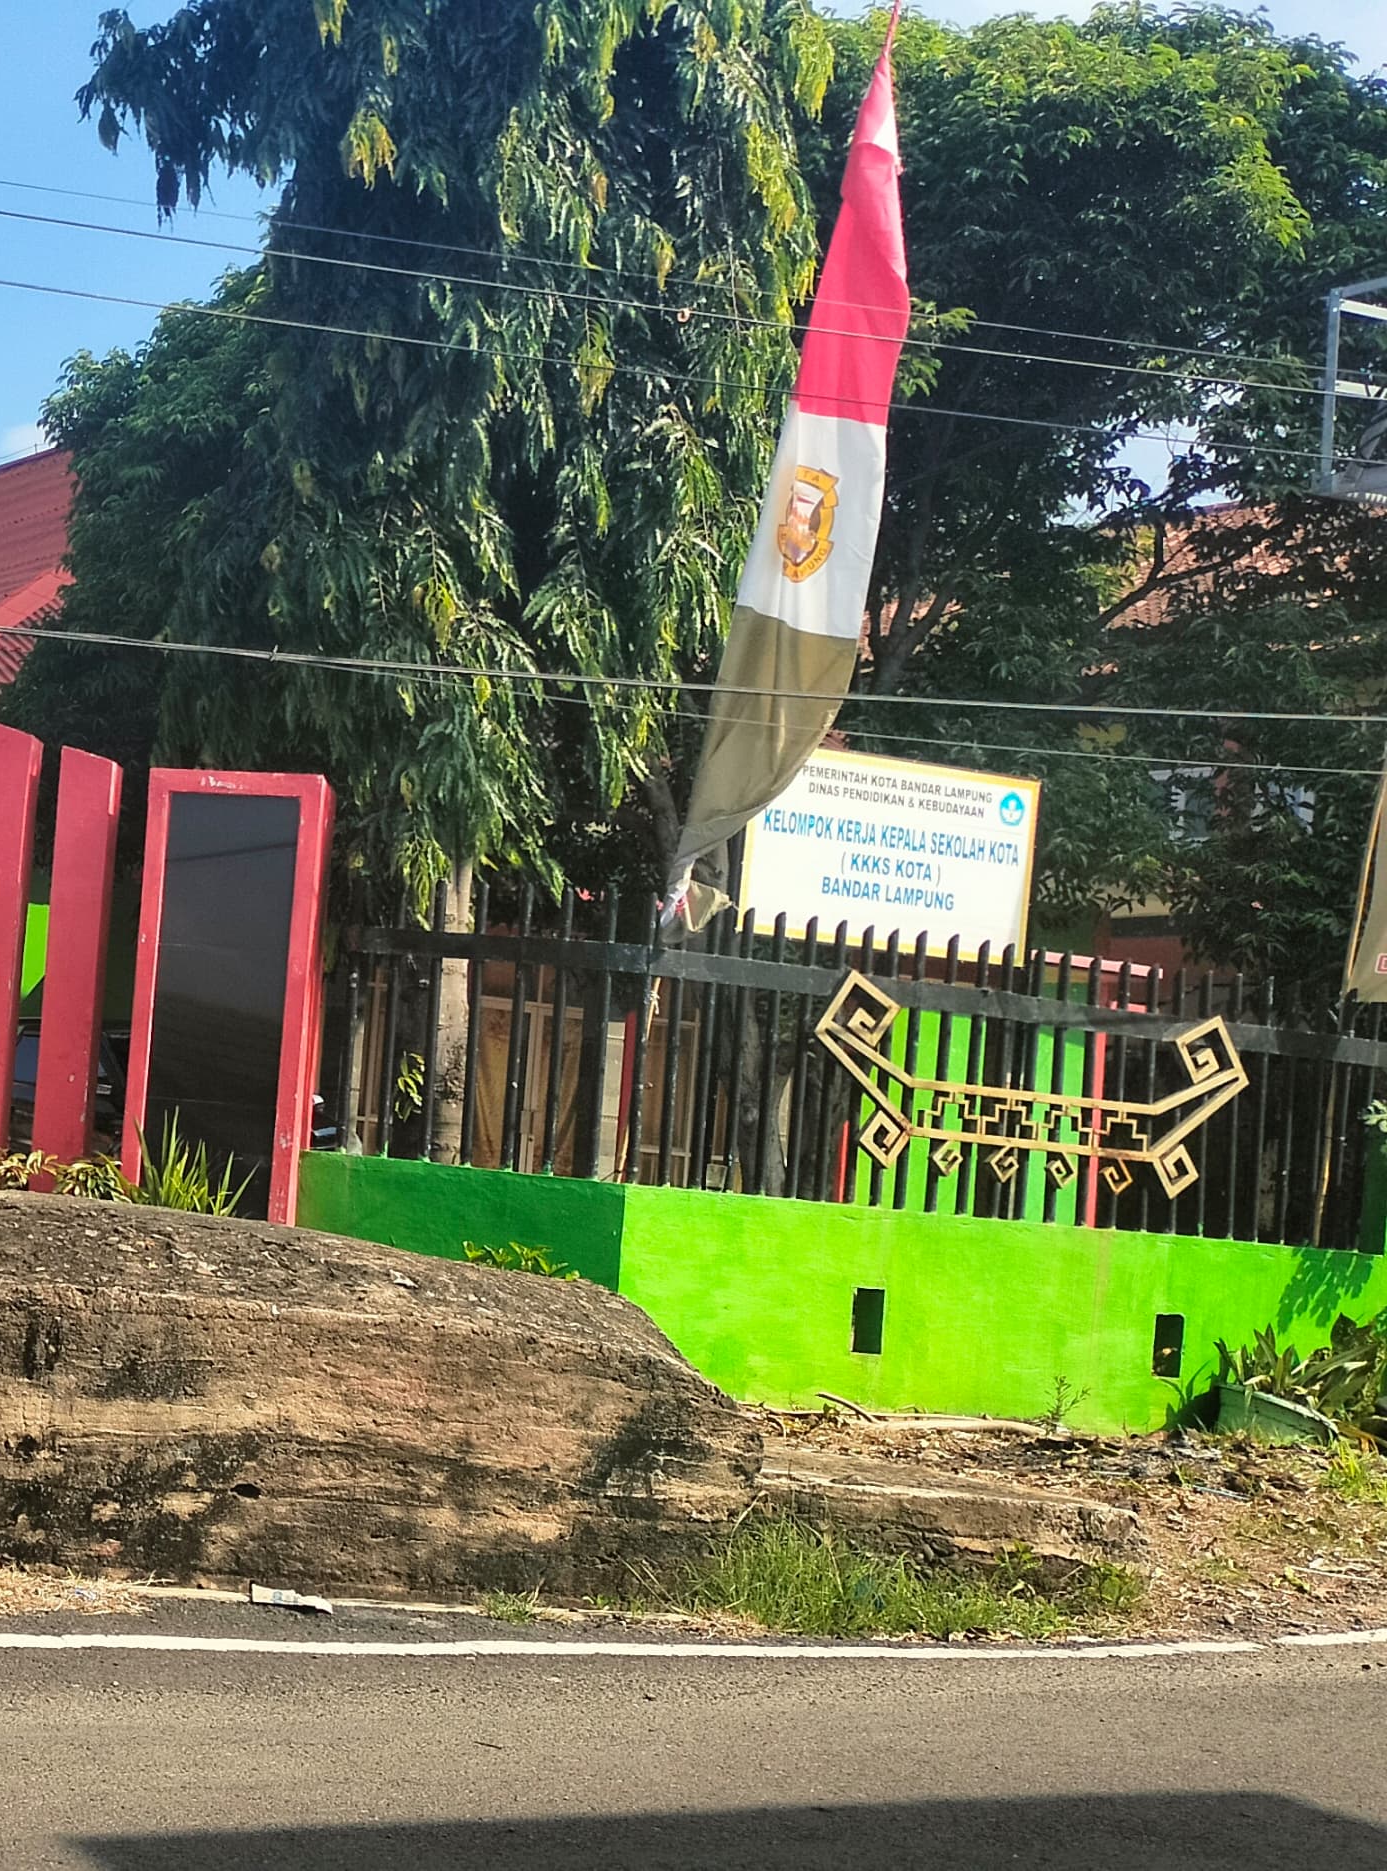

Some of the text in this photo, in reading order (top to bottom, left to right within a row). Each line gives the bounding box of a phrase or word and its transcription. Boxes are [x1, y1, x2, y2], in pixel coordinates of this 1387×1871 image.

[802, 765, 993, 803] PEMERINTAH KOTA BANDAR LAMPUNG
[808, 782, 985, 818] DINAS PENDIDIKAN & KEBUDAYAAN
[763, 808, 1019, 867] KELOMPOK KERJA KEPALA SEKOLAH KOTA
[850, 853, 891, 876] KKKS
[895, 858, 932, 882] KOTA
[821, 876, 954, 911] BANDAR LAMPUNG
